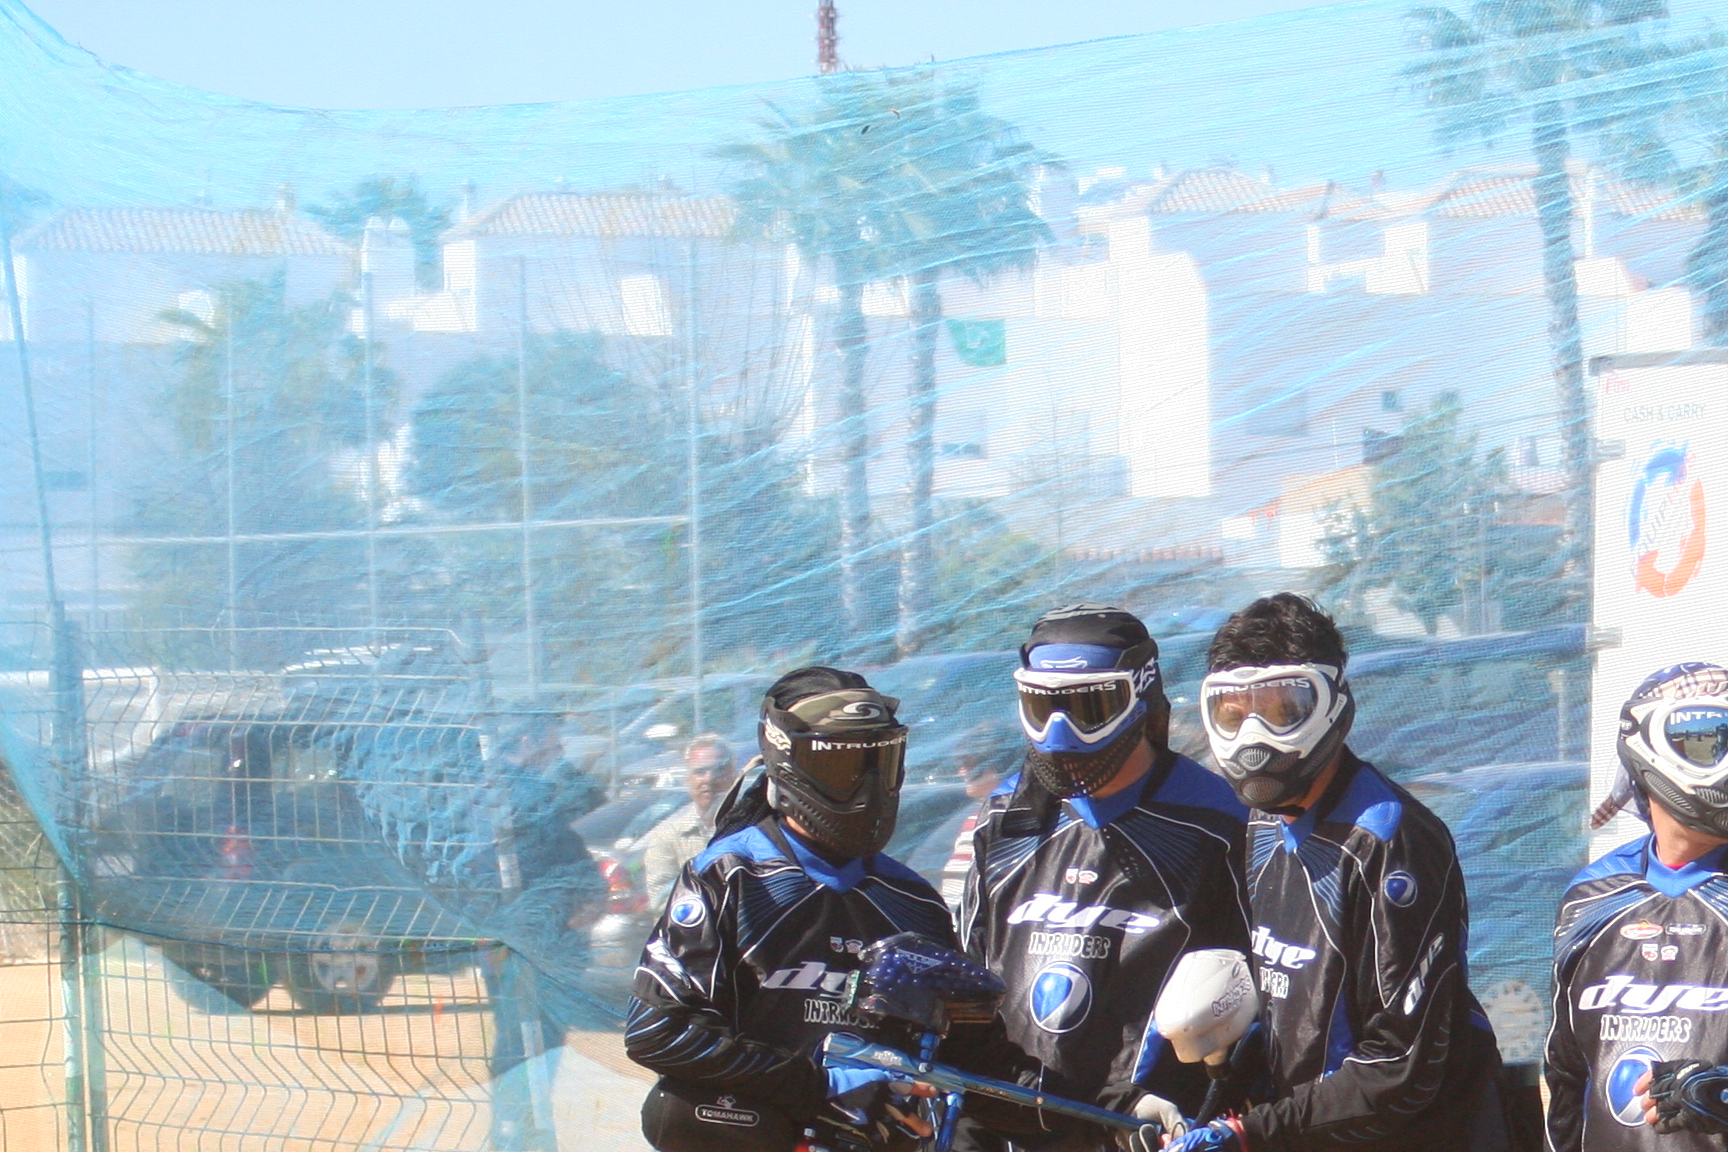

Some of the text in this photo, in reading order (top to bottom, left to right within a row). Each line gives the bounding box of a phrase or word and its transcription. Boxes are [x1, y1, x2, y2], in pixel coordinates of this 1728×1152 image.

[1624, 405, 1653, 423] CASH
[1668, 402, 1706, 421] CARRY
[811, 735, 909, 751] INTRUDER
[1028, 932, 1111, 959] INTRUDERS
[1600, 1013, 1692, 1043] INTRUDERS
[701, 1108, 755, 1123] TOMAHAWK
